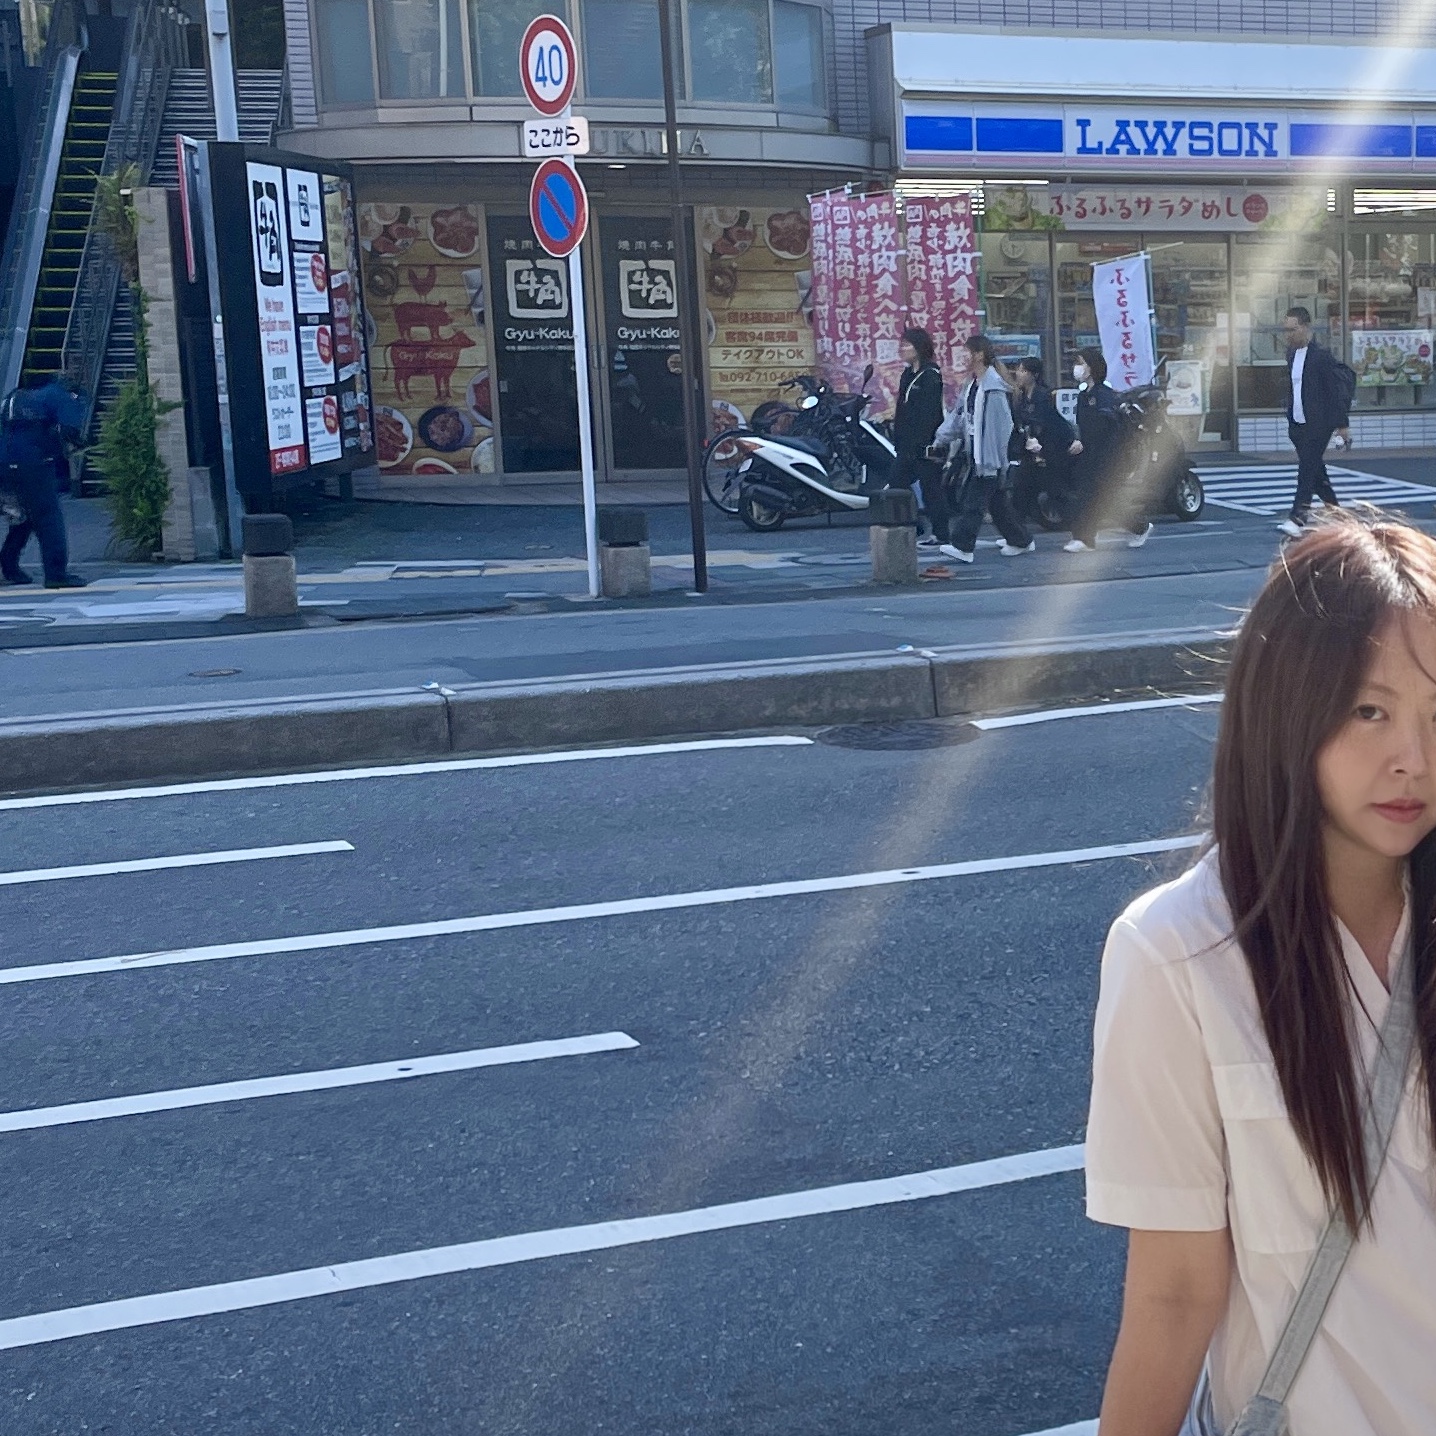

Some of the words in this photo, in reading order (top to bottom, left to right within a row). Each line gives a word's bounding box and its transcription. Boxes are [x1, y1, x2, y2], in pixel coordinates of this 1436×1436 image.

[535, 44, 562, 87] 40
[529, 126, 580, 149] ここから
[1076, 118, 1278, 157] LAWSON
[1050, 195, 1239, 220] ふるふるサラダめし
[721, 348, 805, 361] テイクアウトOK
